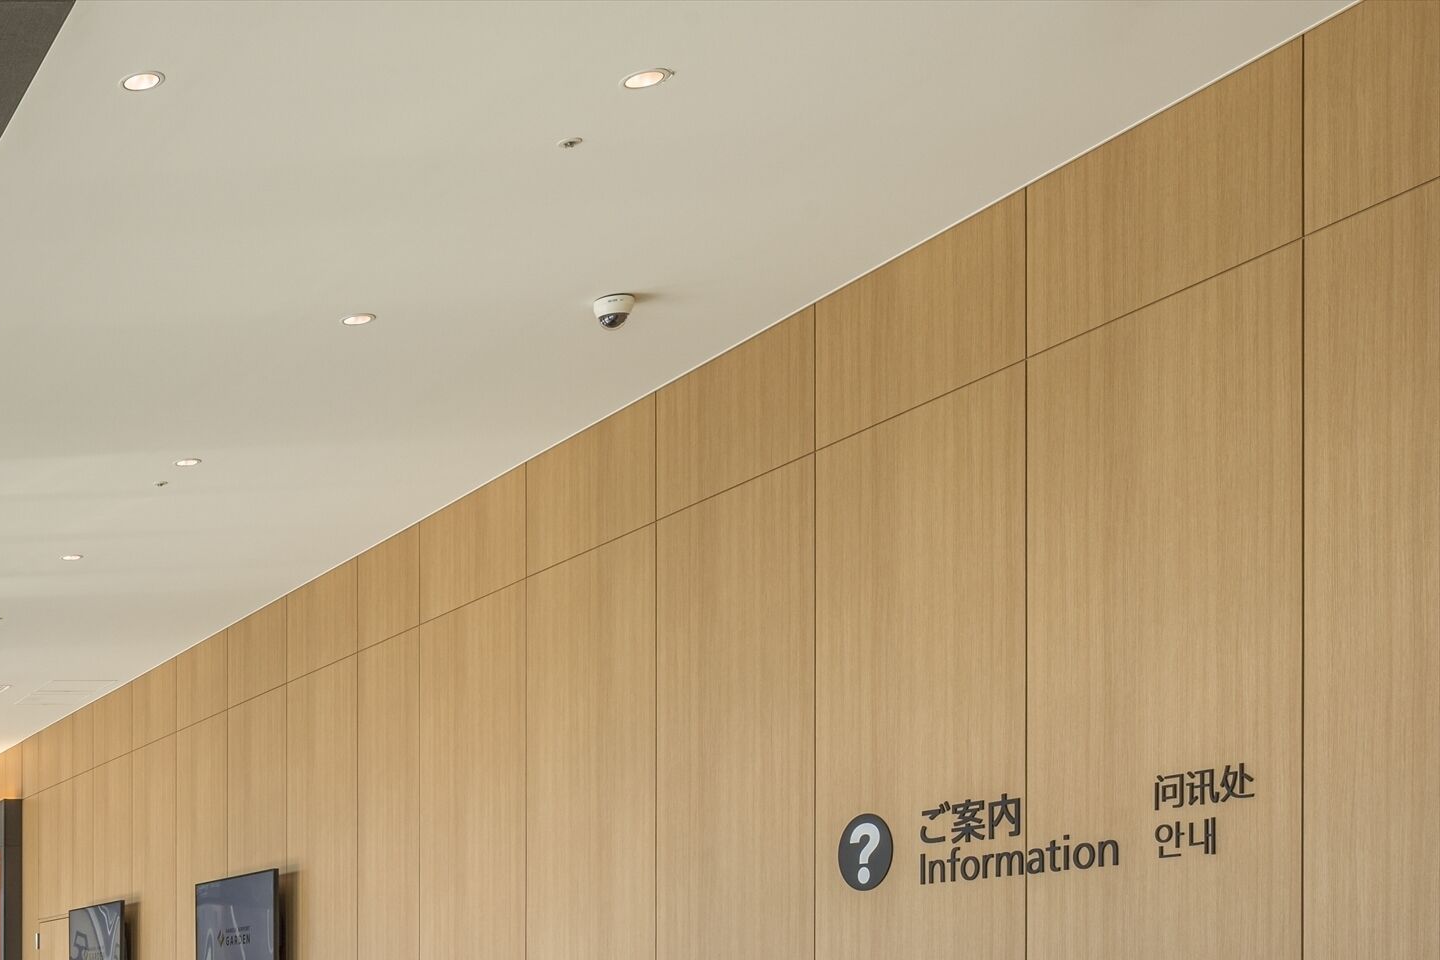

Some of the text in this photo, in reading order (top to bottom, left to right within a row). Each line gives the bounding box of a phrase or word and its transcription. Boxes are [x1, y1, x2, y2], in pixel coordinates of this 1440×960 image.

[1154, 762, 1255, 811] 问讯处
[919, 793, 1022, 844] ご案内
[1154, 816, 1217, 859] 안내
[919, 834, 1119, 885] Information
[225, 933, 251, 947] GARDEN
